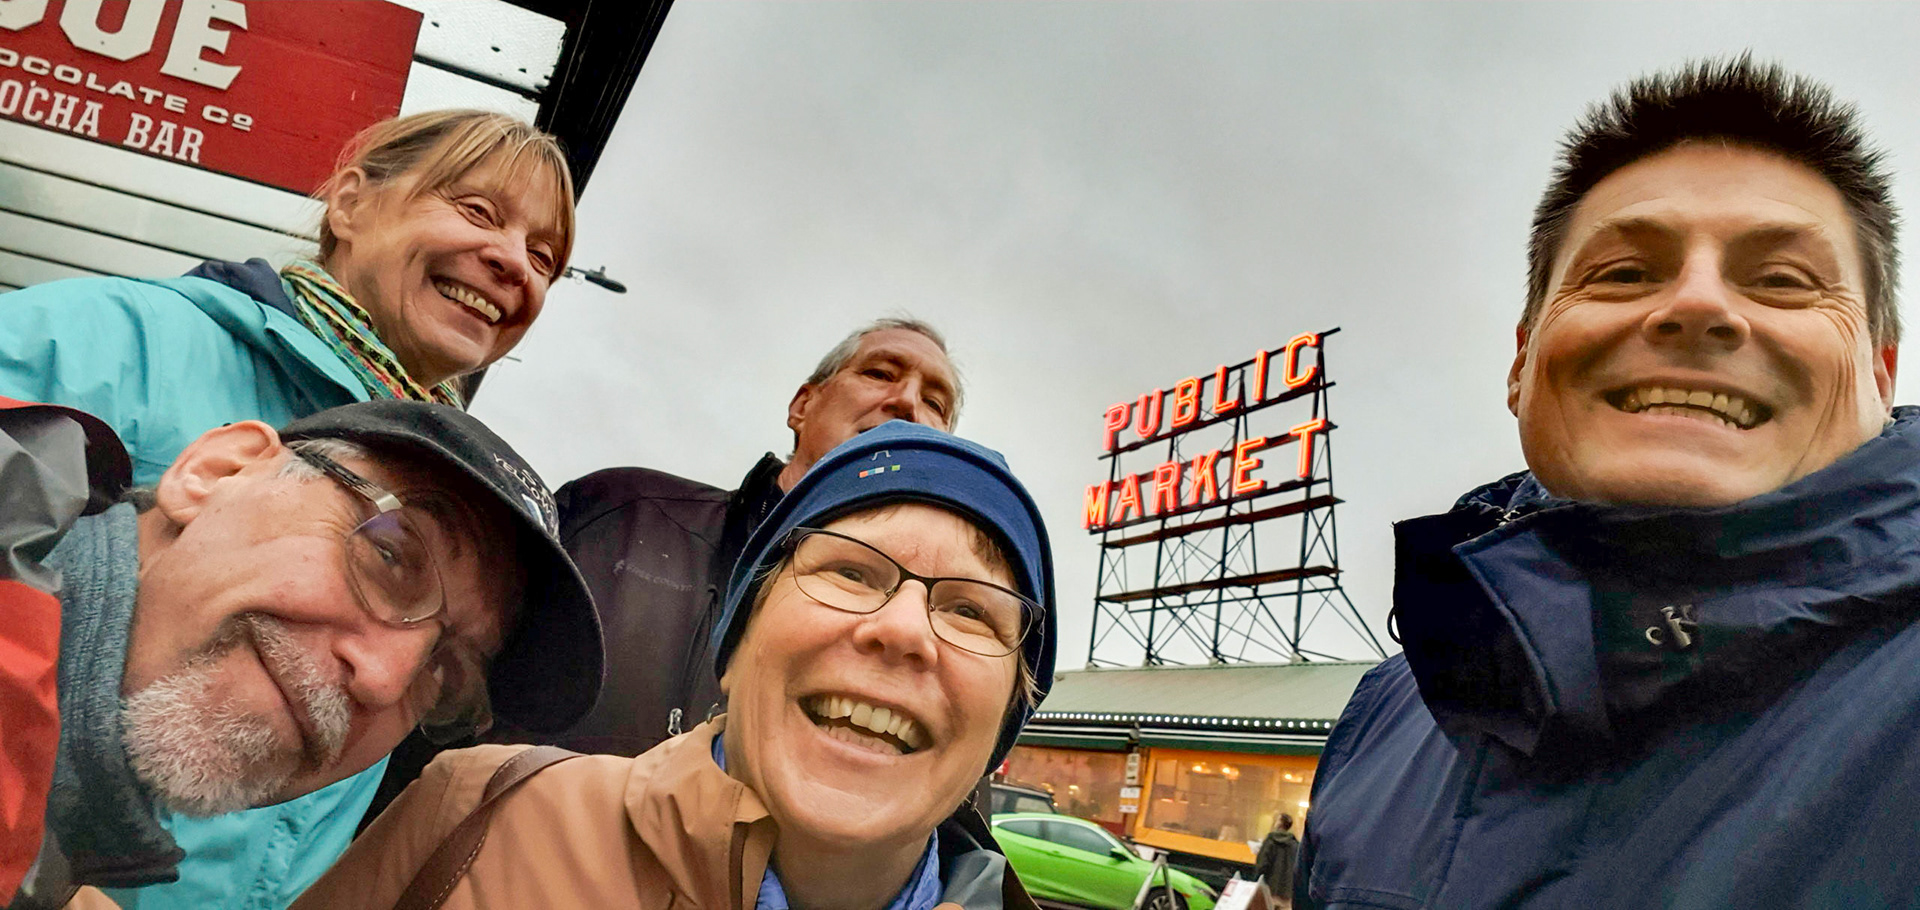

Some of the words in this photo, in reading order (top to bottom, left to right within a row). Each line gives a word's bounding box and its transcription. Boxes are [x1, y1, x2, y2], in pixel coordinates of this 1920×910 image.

[123, 112, 204, 164] BAR
[1102, 331, 1320, 452] PUBLIC
[1080, 418, 1327, 530] MARKET
